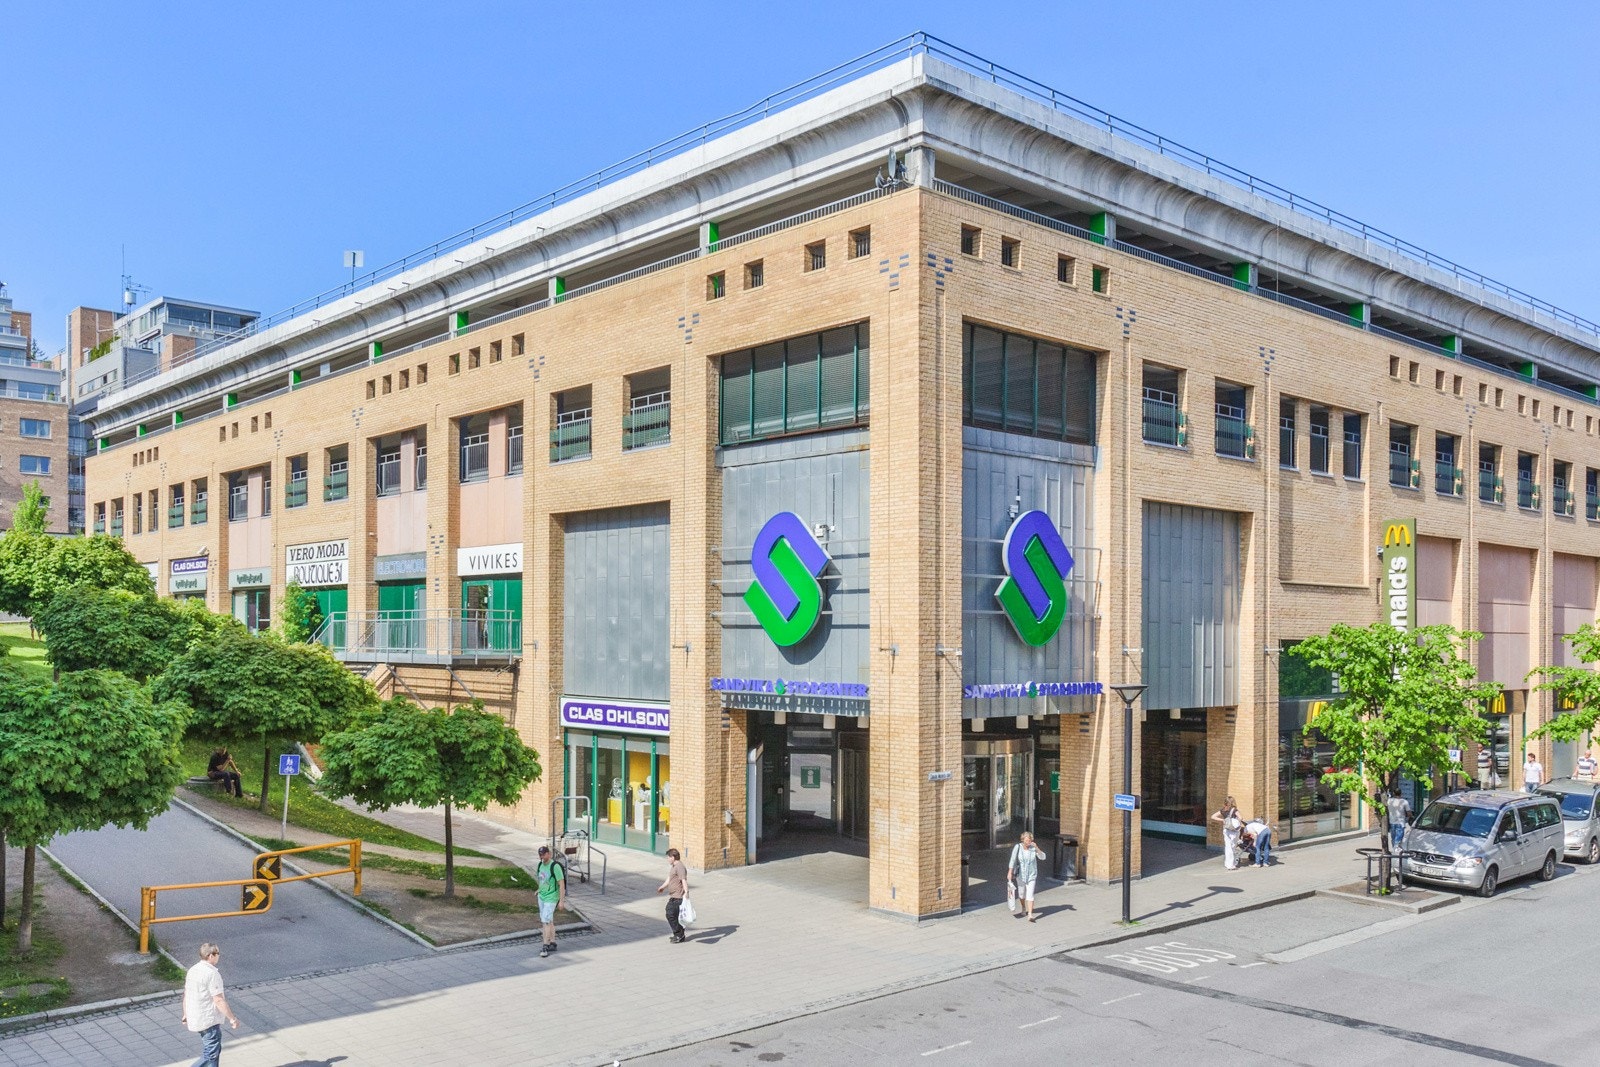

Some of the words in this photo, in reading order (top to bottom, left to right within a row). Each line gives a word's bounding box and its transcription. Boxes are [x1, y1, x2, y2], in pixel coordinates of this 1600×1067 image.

[290, 547, 315, 561] VERO
[316, 543, 345, 558] MODA
[469, 552, 518, 570] VIVIKES
[174, 562, 186, 571] CLAS
[186, 560, 207, 570] OHLSON
[293, 563, 334, 584] BOUTIQUE
[710, 677, 774, 693] SANDVIKA
[786, 680, 869, 698] STORSENTER
[964, 684, 1028, 699] SANDVIKA
[1038, 682, 1104, 697] STORSENTER
[568, 706, 604, 722] CLAS
[606, 710, 669, 727] OHLSON
[1104, 941, 1238, 974] BUSS
